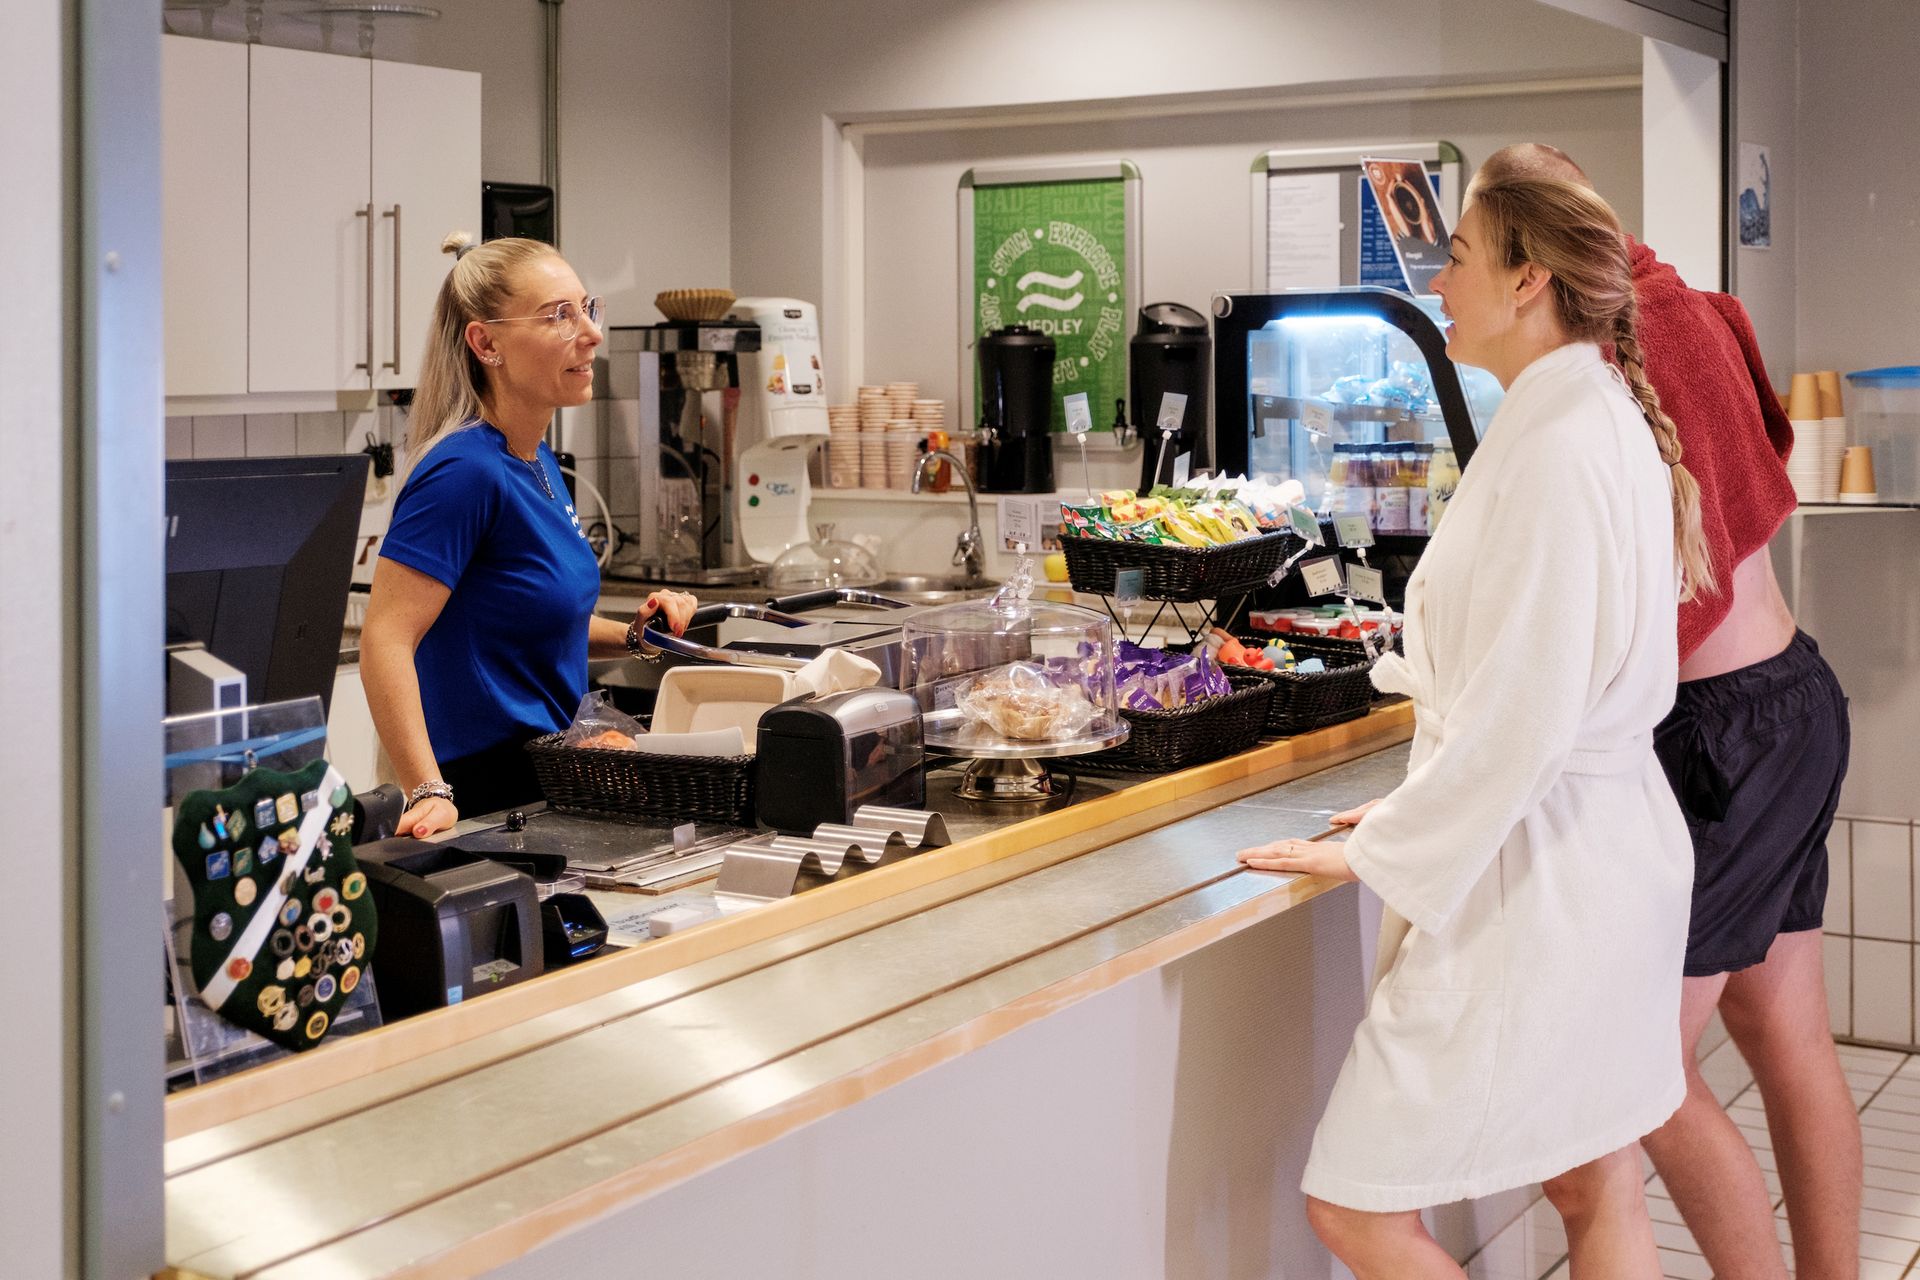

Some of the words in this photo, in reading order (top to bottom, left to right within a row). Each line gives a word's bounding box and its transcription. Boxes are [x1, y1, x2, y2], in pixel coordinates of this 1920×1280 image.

[1052, 195, 1102, 214] RELAX
[990, 228, 1033, 276] SWIM
[1048, 221, 1121, 290] EXERCISE
[980, 293, 1002, 336] JOY
[1088, 306, 1122, 361] PLAY
